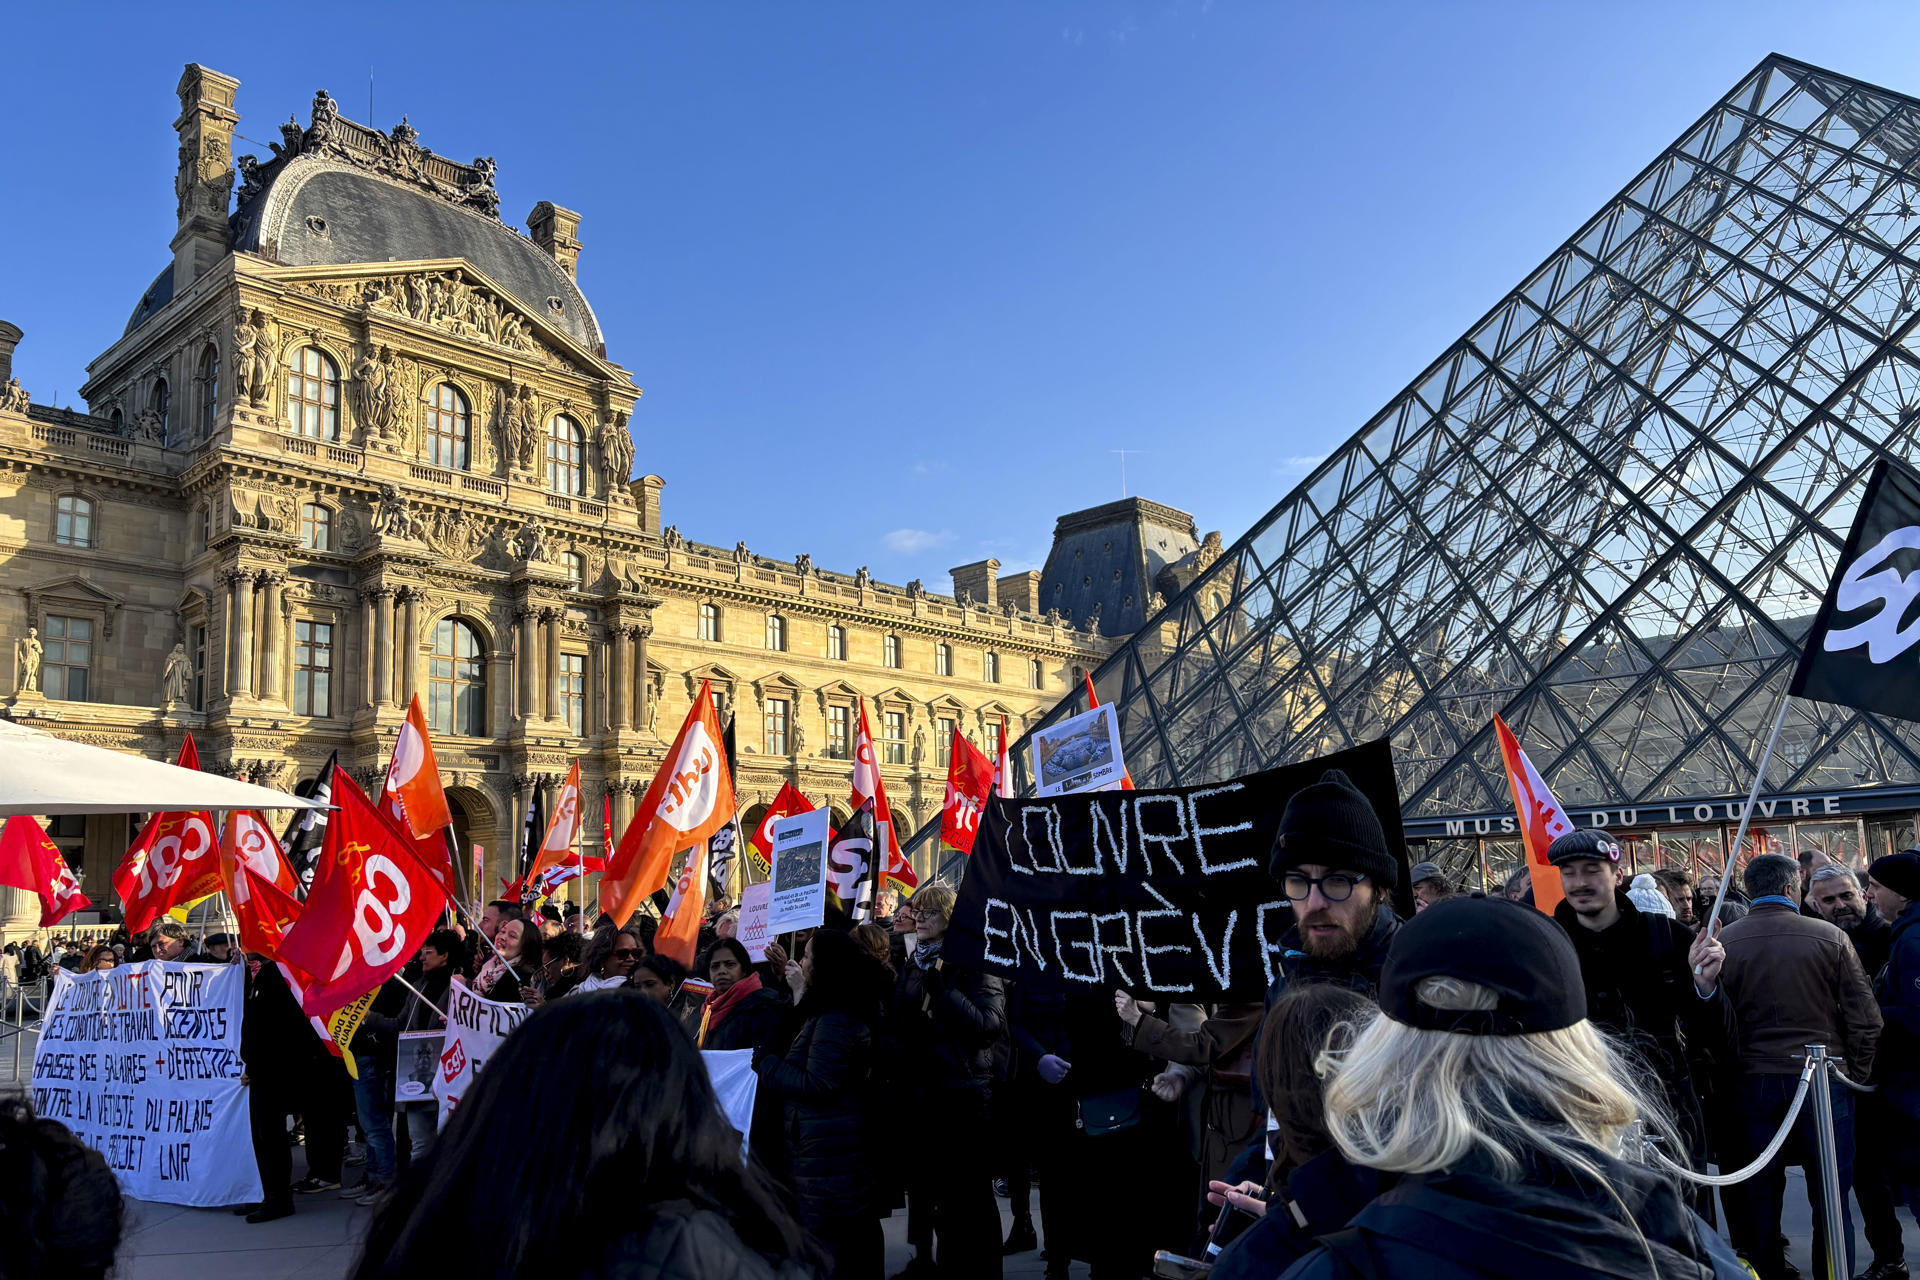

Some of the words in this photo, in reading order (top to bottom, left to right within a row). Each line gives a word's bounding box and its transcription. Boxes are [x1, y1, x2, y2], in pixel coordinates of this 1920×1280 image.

[1000, 783, 1258, 876] LOUVRE
[1446, 816, 1516, 836] MUS
[1592, 809, 1638, 828] DU
[1668, 796, 1841, 823] LOUVRE
[984, 898, 1047, 971] EN
[114, 971, 151, 1011] LUTTE
[160, 971, 204, 1008] POUR
[119, 1009, 158, 1043] TRAVAIL
[80, 1053, 97, 1082] DES
[105, 1053, 147, 1084] SALAIRES
[445, 1044, 464, 1076] cgt
[34, 1087, 72, 1118] ONTRE
[78, 1091, 92, 1121] LA
[145, 1098, 163, 1133] DU
[167, 1099, 213, 1133] PALAIS
[160, 1143, 191, 1182] LNR
